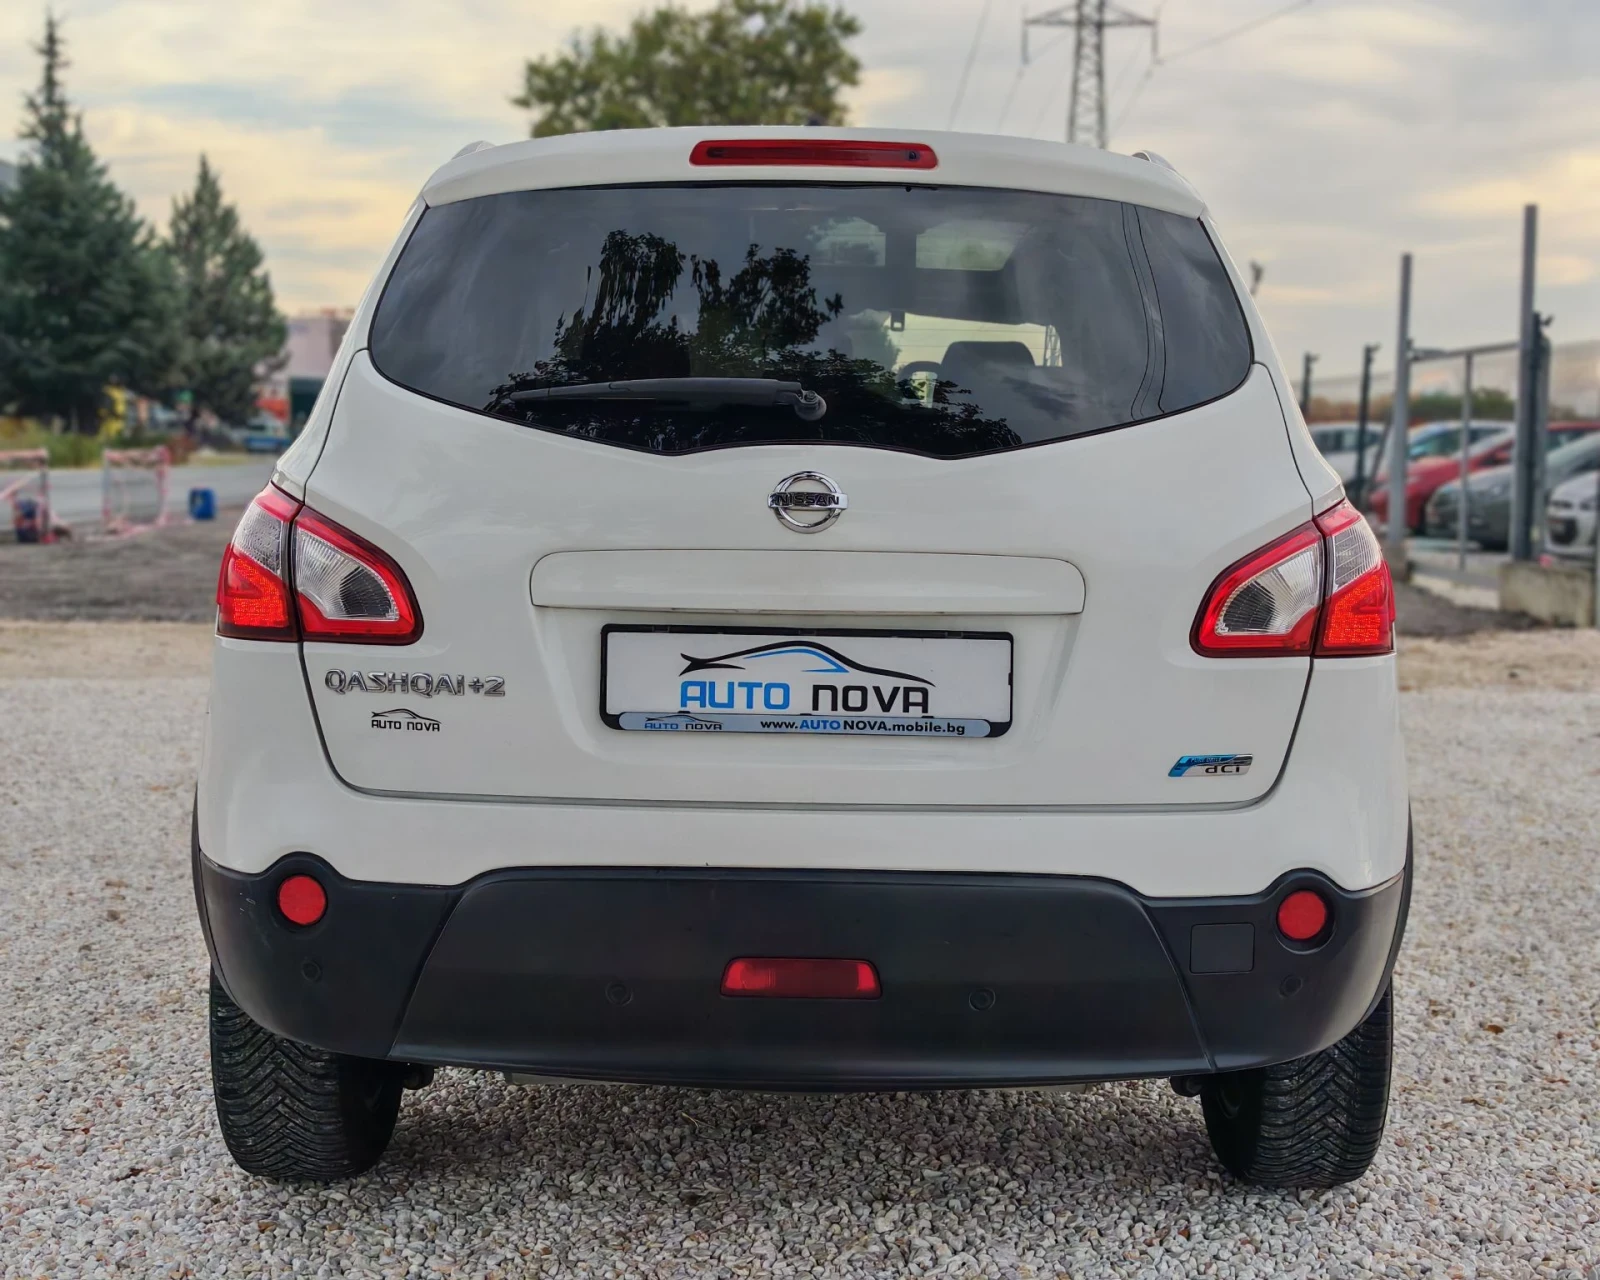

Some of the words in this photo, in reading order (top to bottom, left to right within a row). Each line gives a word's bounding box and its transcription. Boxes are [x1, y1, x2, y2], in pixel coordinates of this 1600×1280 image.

[777, 493, 839, 506] NISSAN
[325, 669, 505, 698] QASHQAI+2
[680, 681, 790, 710] AUTO
[811, 684, 929, 714] NOVA
[371, 719, 402, 731] AUTO
[406, 721, 441, 733] NOVA
[644, 722, 680, 731] AUTO
[685, 722, 723, 731] NOVA
